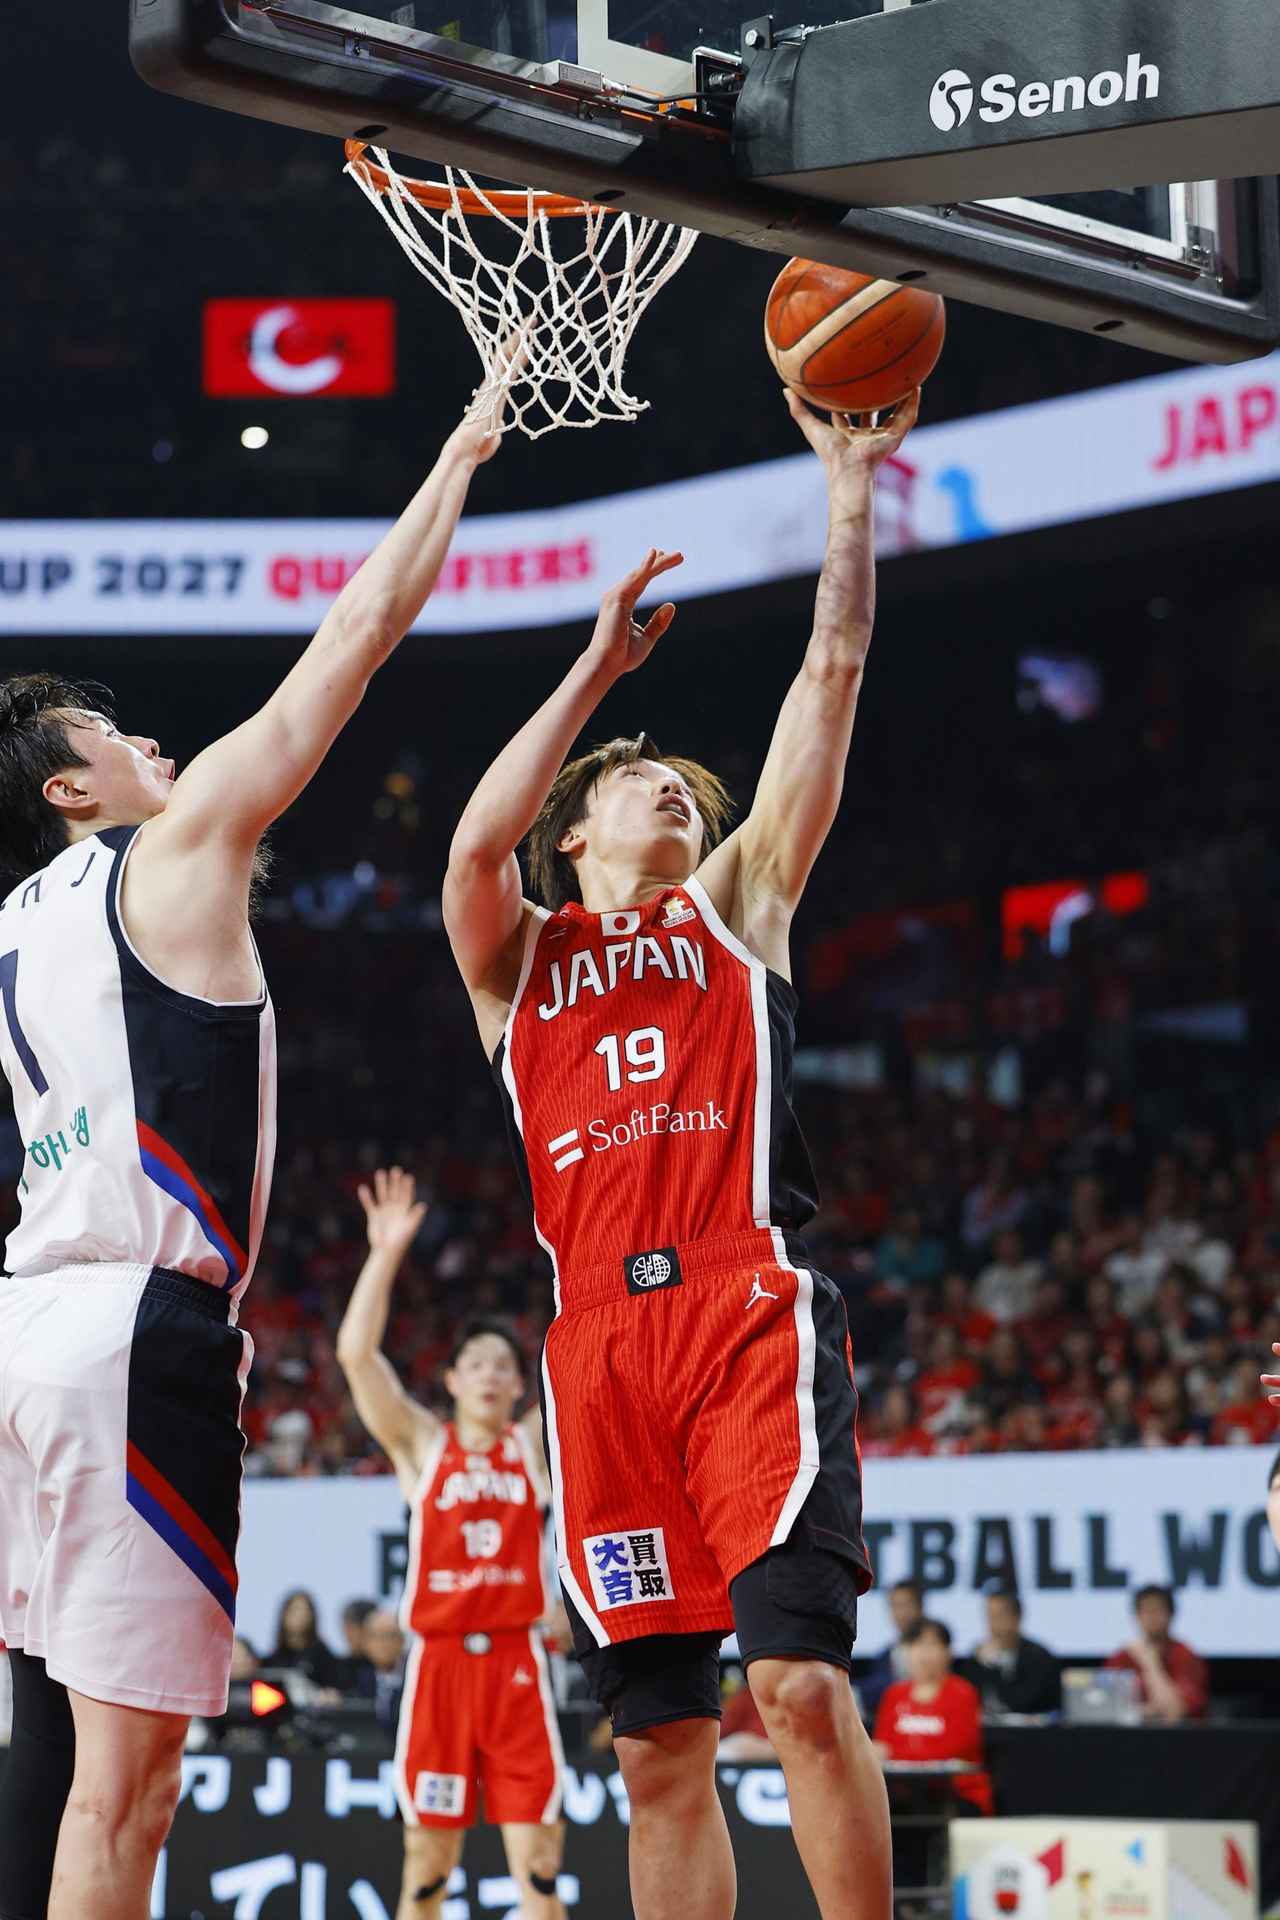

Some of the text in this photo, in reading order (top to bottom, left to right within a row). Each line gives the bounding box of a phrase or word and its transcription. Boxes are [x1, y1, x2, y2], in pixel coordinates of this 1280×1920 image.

[979, 53, 1160, 123] Senoh
[1153, 387, 1277, 470] JAP
[97, 556, 246, 596] 2027
[268, 538, 595, 601] QUFIERS
[537, 935, 708, 1022] JAPAN
[593, 1025, 667, 1092] 19
[588, 1101, 729, 1152] SoftBank
